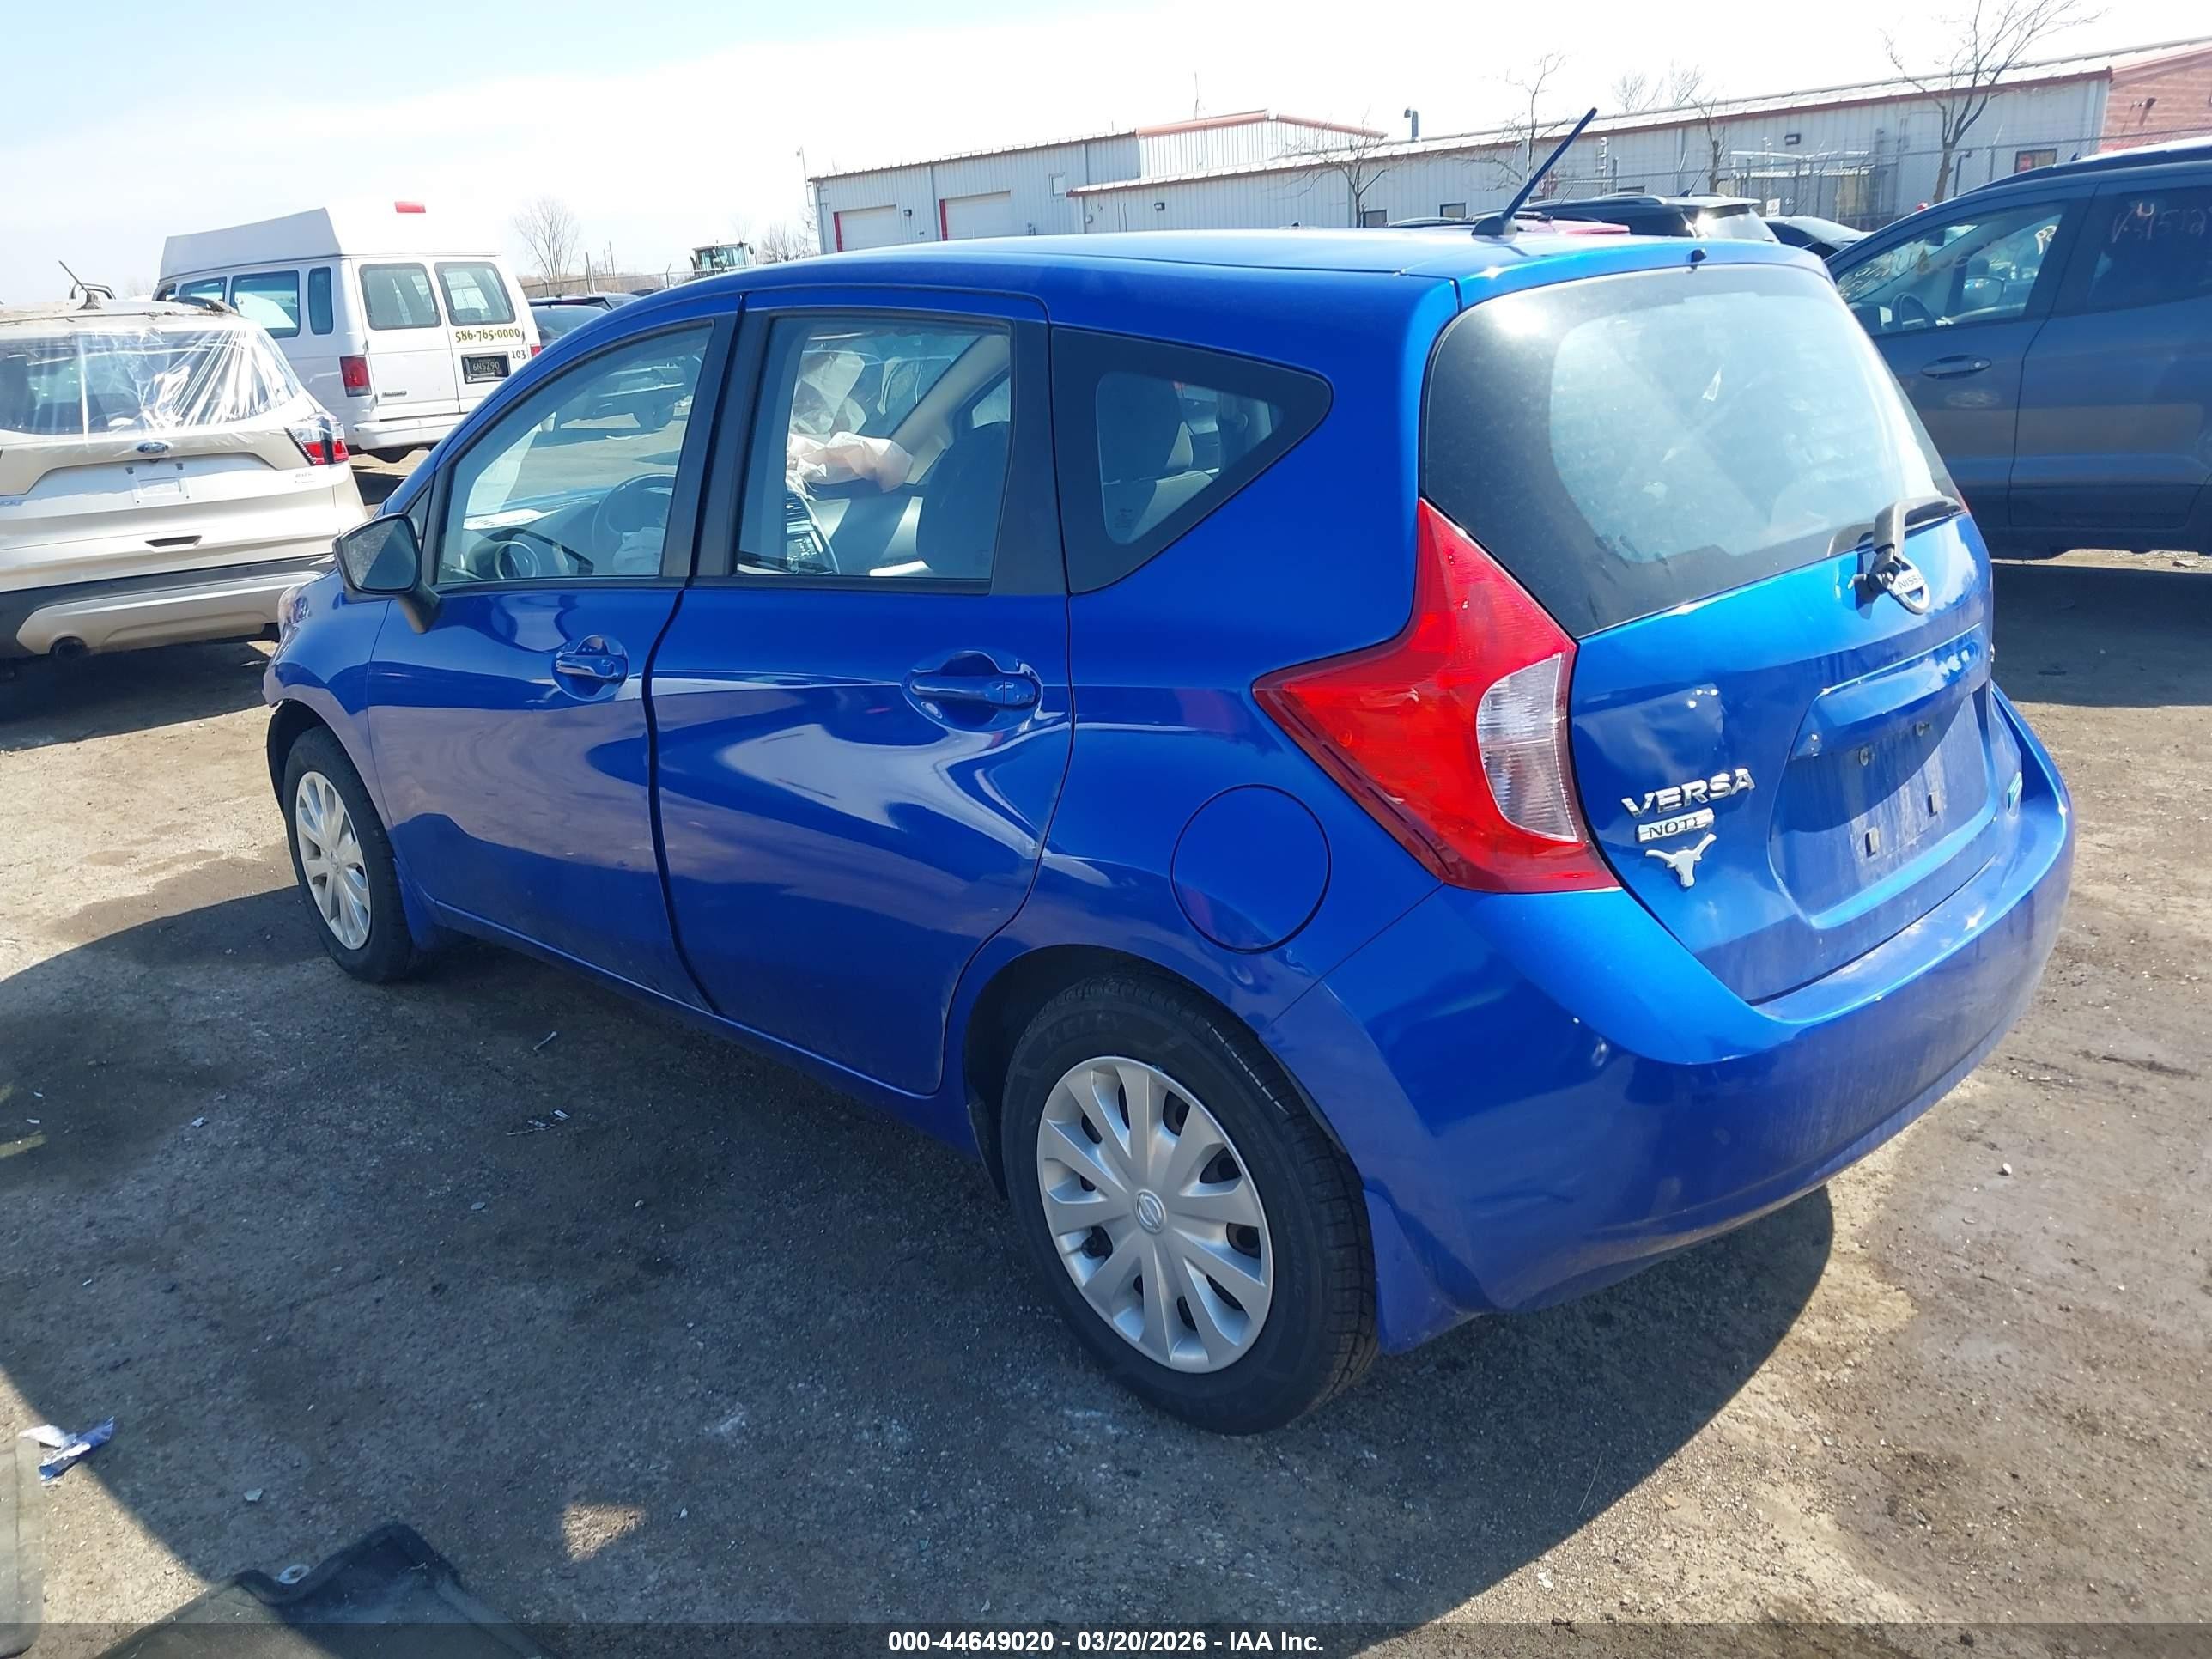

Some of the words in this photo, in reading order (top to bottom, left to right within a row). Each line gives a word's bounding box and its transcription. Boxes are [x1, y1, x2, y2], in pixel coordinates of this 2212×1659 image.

[511, 349, 526, 360] 103
[1620, 767, 1756, 818] VERSA
[1648, 813, 1705, 838] NOTE
